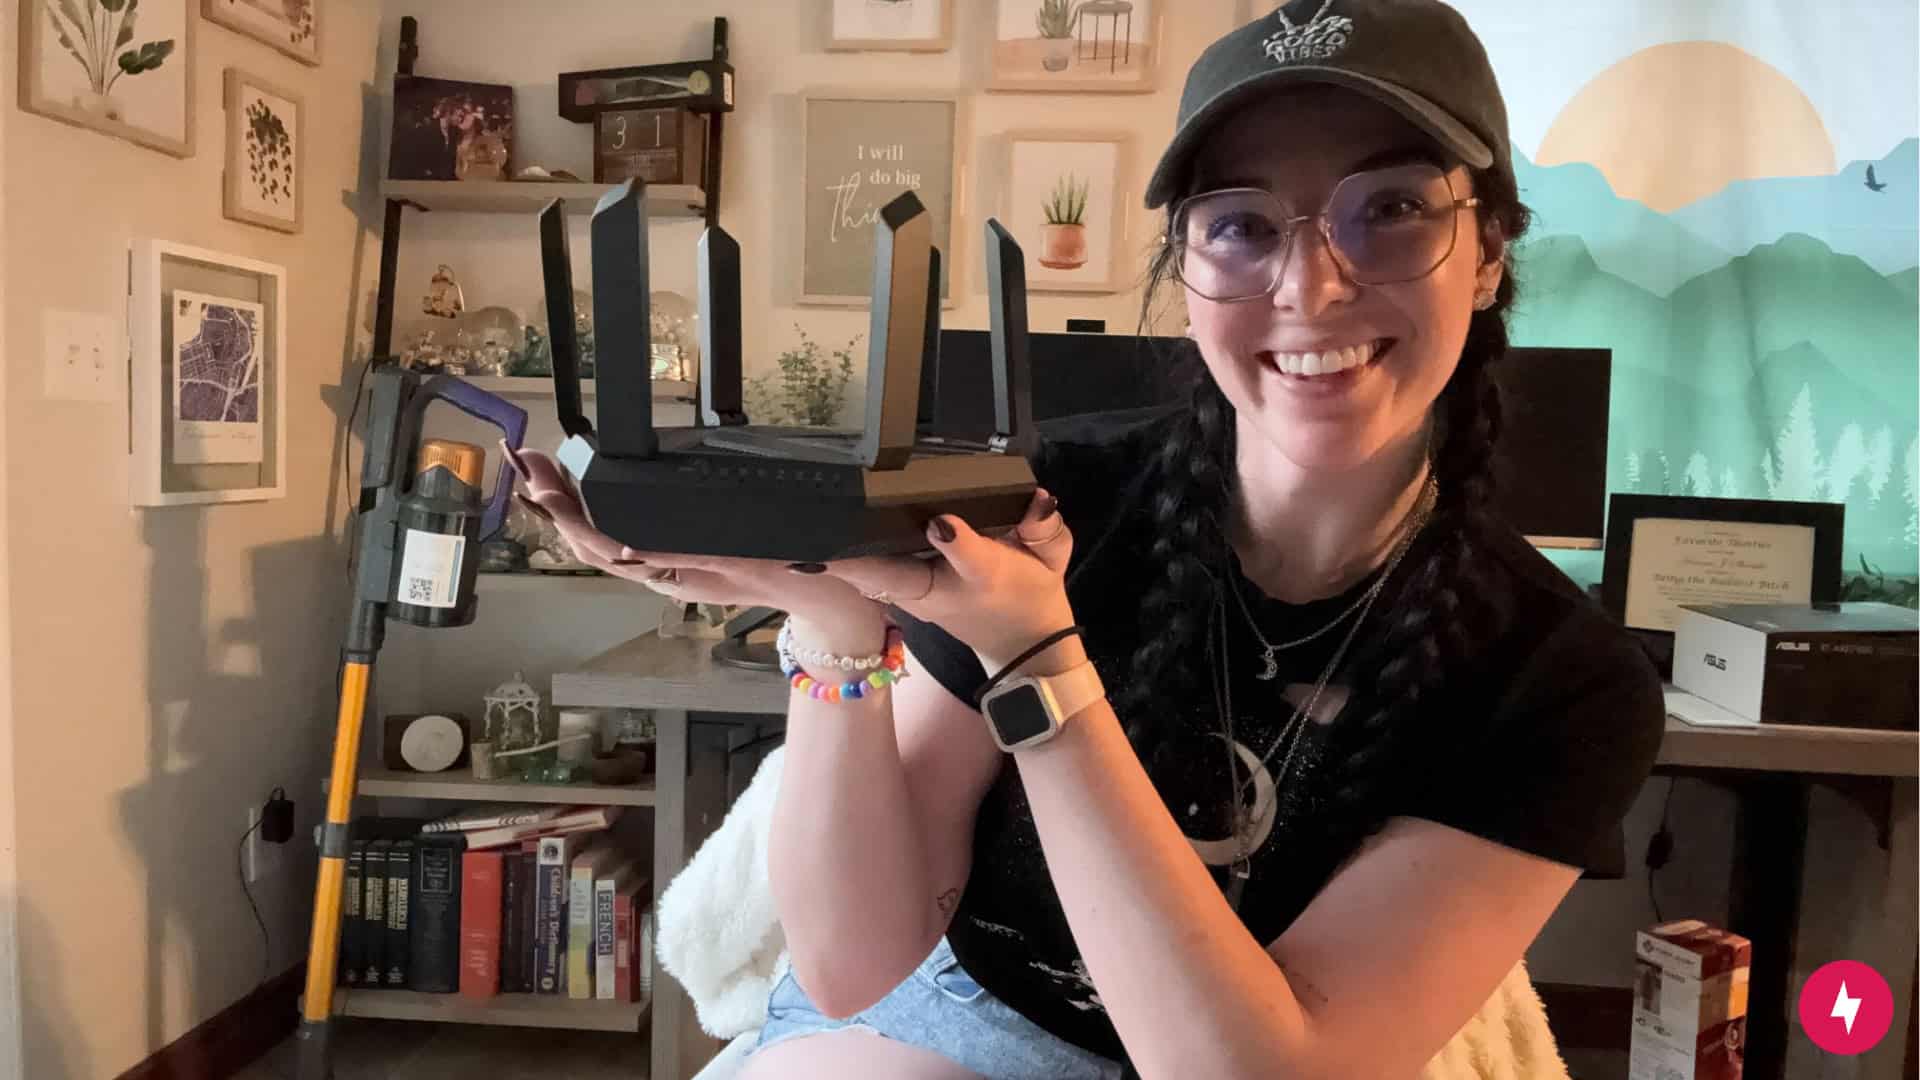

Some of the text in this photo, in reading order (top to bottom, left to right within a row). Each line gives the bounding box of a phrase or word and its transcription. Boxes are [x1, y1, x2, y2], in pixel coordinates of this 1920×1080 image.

[1274, 45, 1337, 63] VIBES
[857, 144, 904, 161] I will
[869, 168, 921, 189] do big
[1776, 641, 1811, 651] ASUS
[1703, 653, 1727, 672] ASUS
[599, 894, 613, 954] FRENCH
